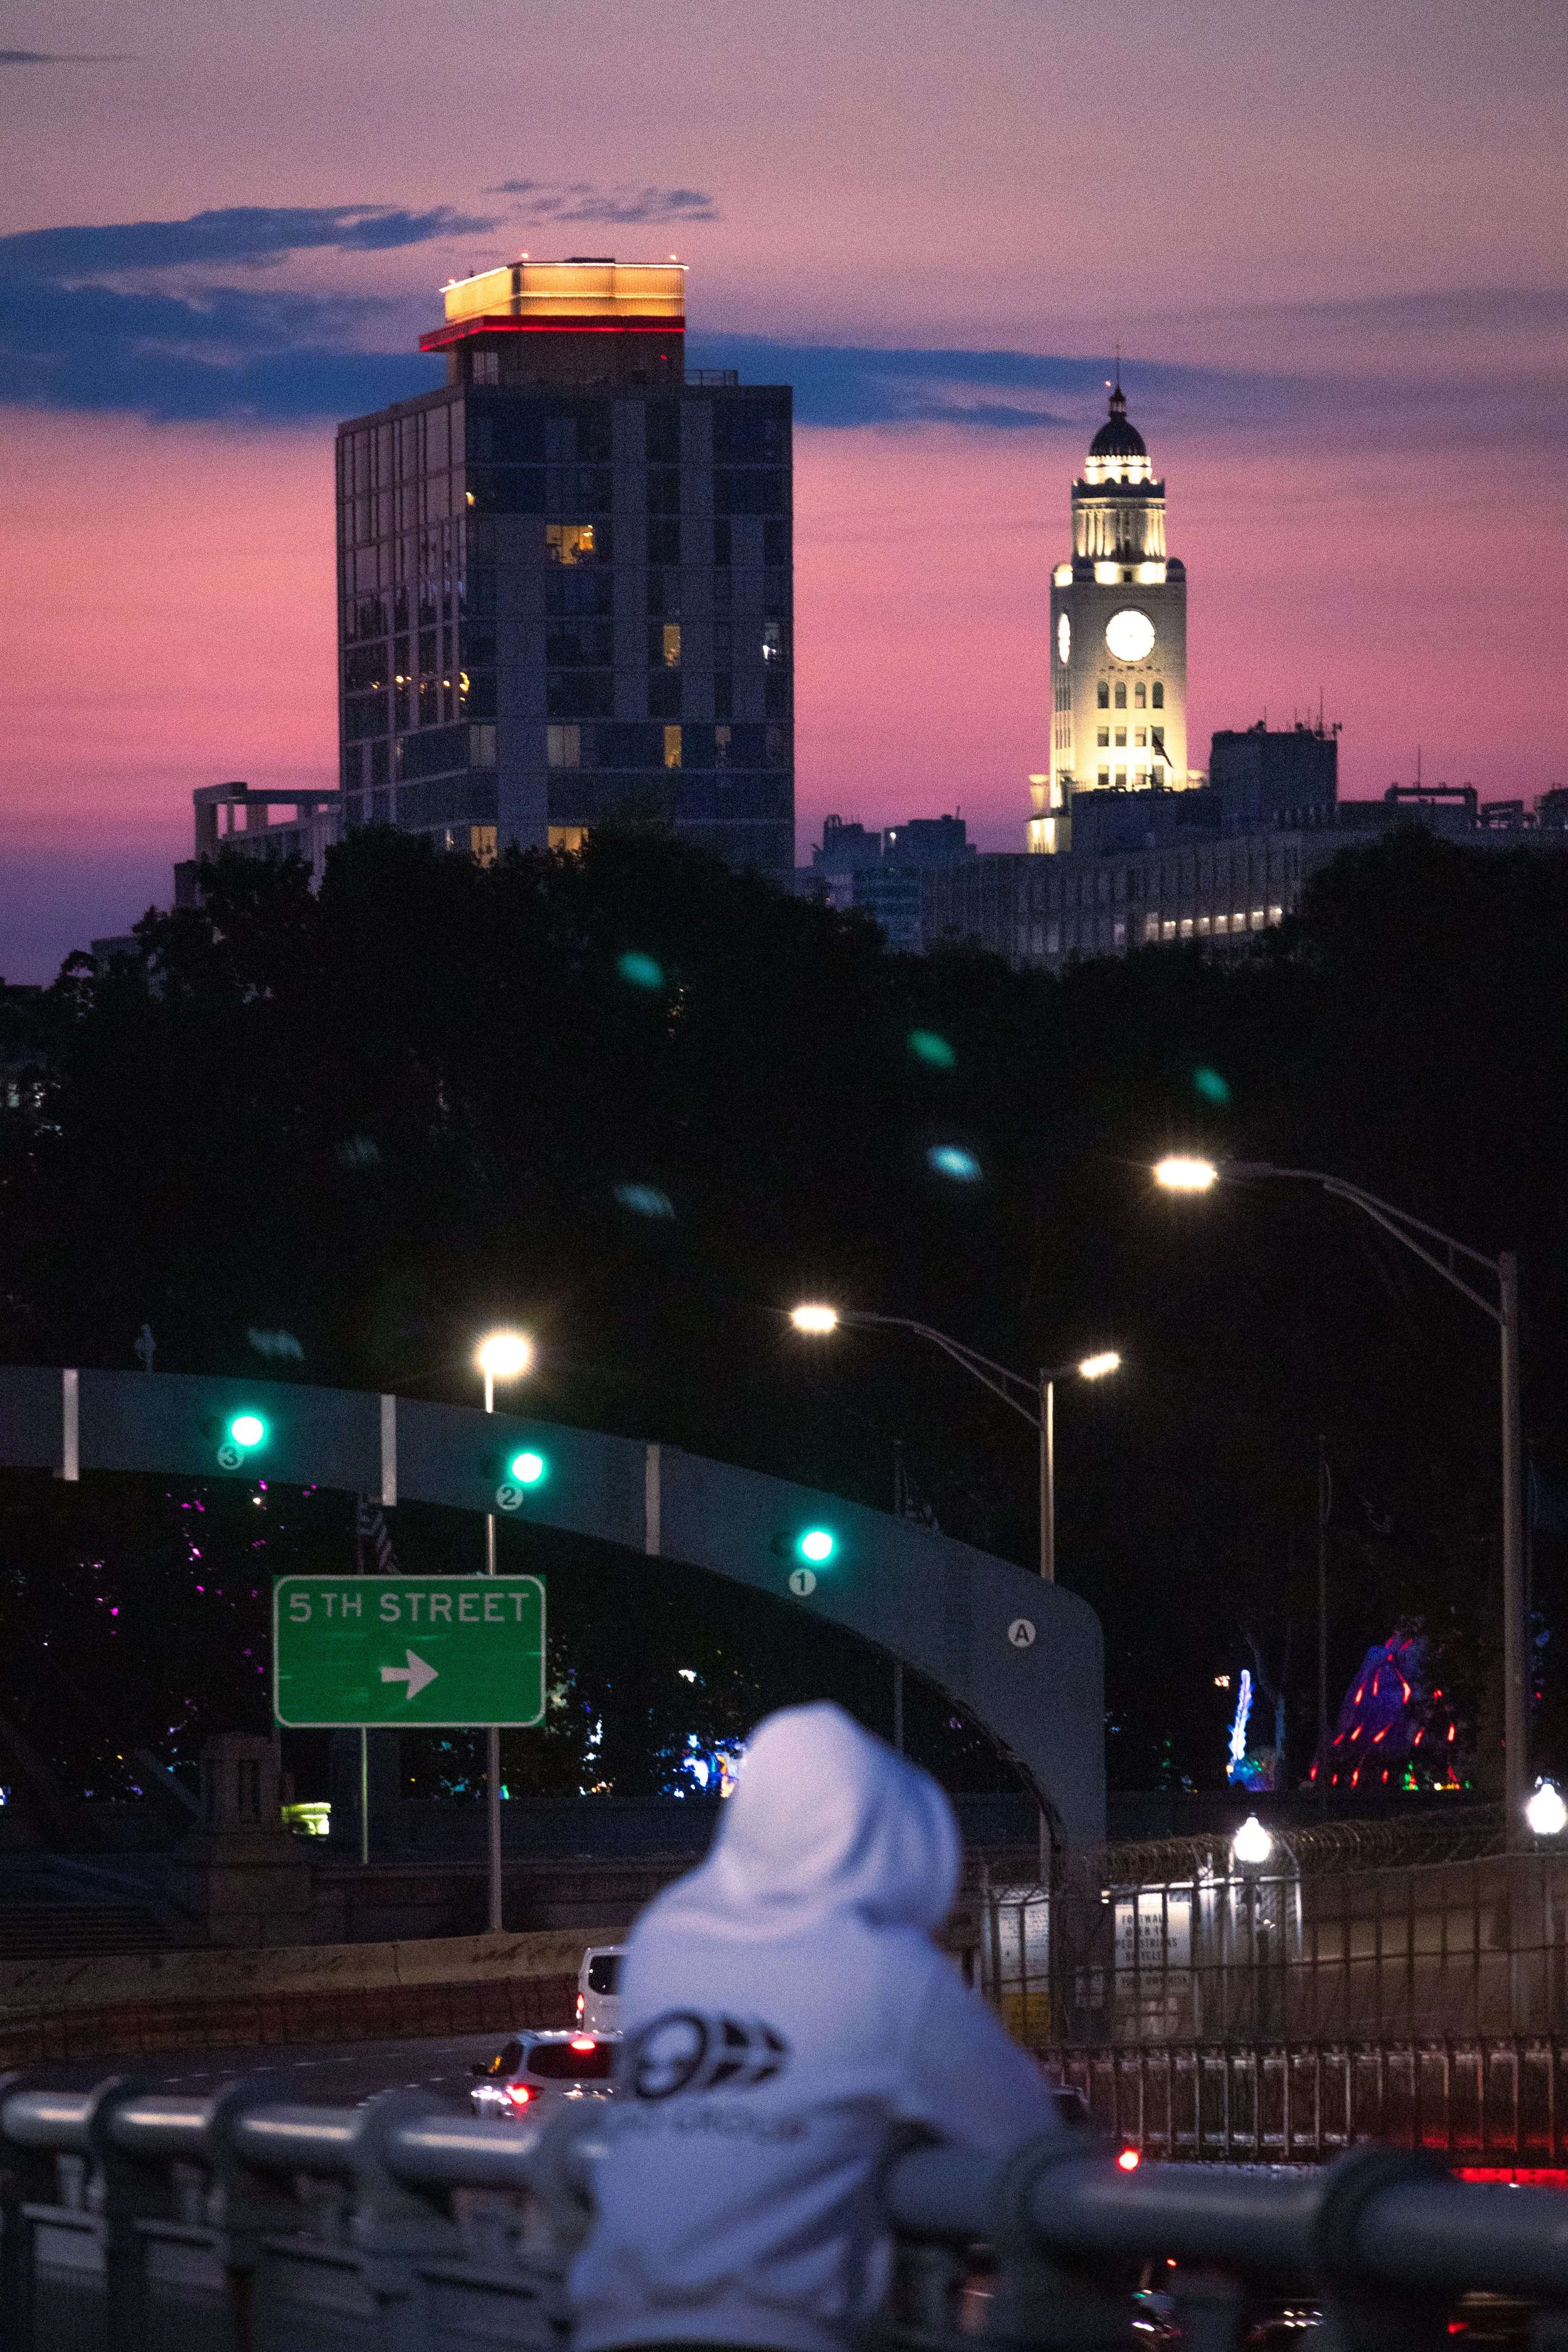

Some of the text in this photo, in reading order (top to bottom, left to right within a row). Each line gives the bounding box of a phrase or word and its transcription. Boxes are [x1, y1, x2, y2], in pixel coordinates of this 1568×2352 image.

[222, 1446, 238, 1466] 3
[502, 1486, 517, 1505] 2
[796, 1572, 806, 1592] 1
[379, 1593, 529, 1622] STREET
[1014, 1623, 1030, 1643] A
